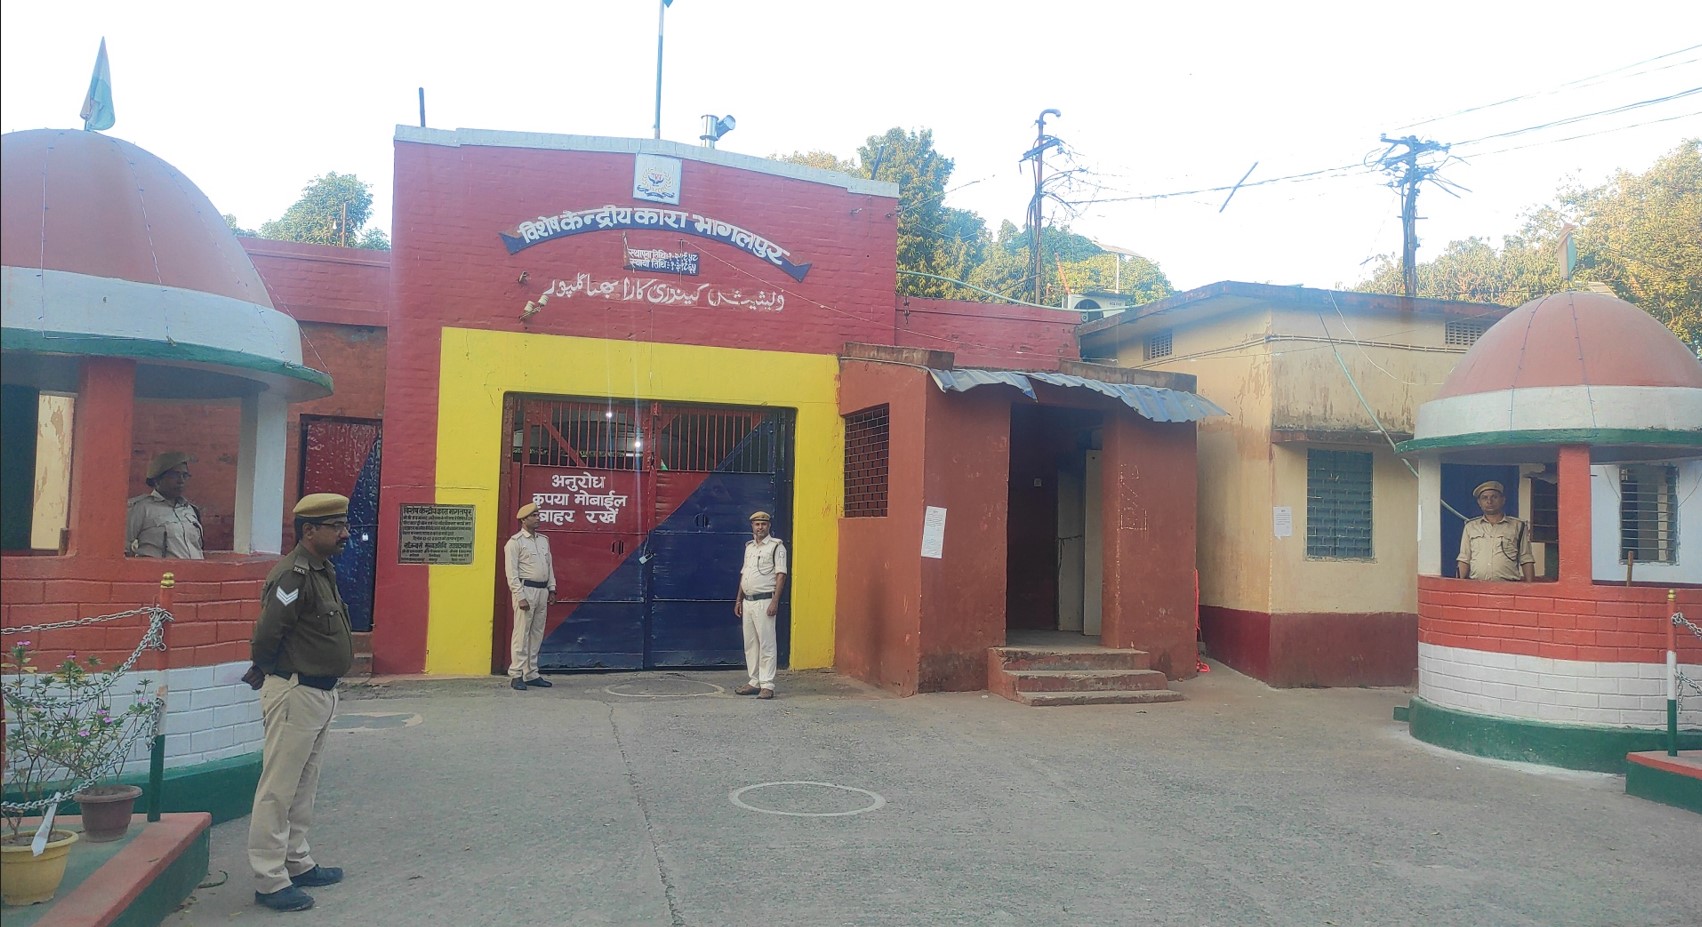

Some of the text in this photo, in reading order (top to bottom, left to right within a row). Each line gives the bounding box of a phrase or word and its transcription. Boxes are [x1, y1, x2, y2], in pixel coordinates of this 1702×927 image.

[517, 204, 790, 265] विशेष केन्द्रीय कारा भागलपुर
[551, 471, 606, 492] अनुरोध
[532, 493, 570, 509] कृपया
[538, 508, 619, 526] बाहर रखें
